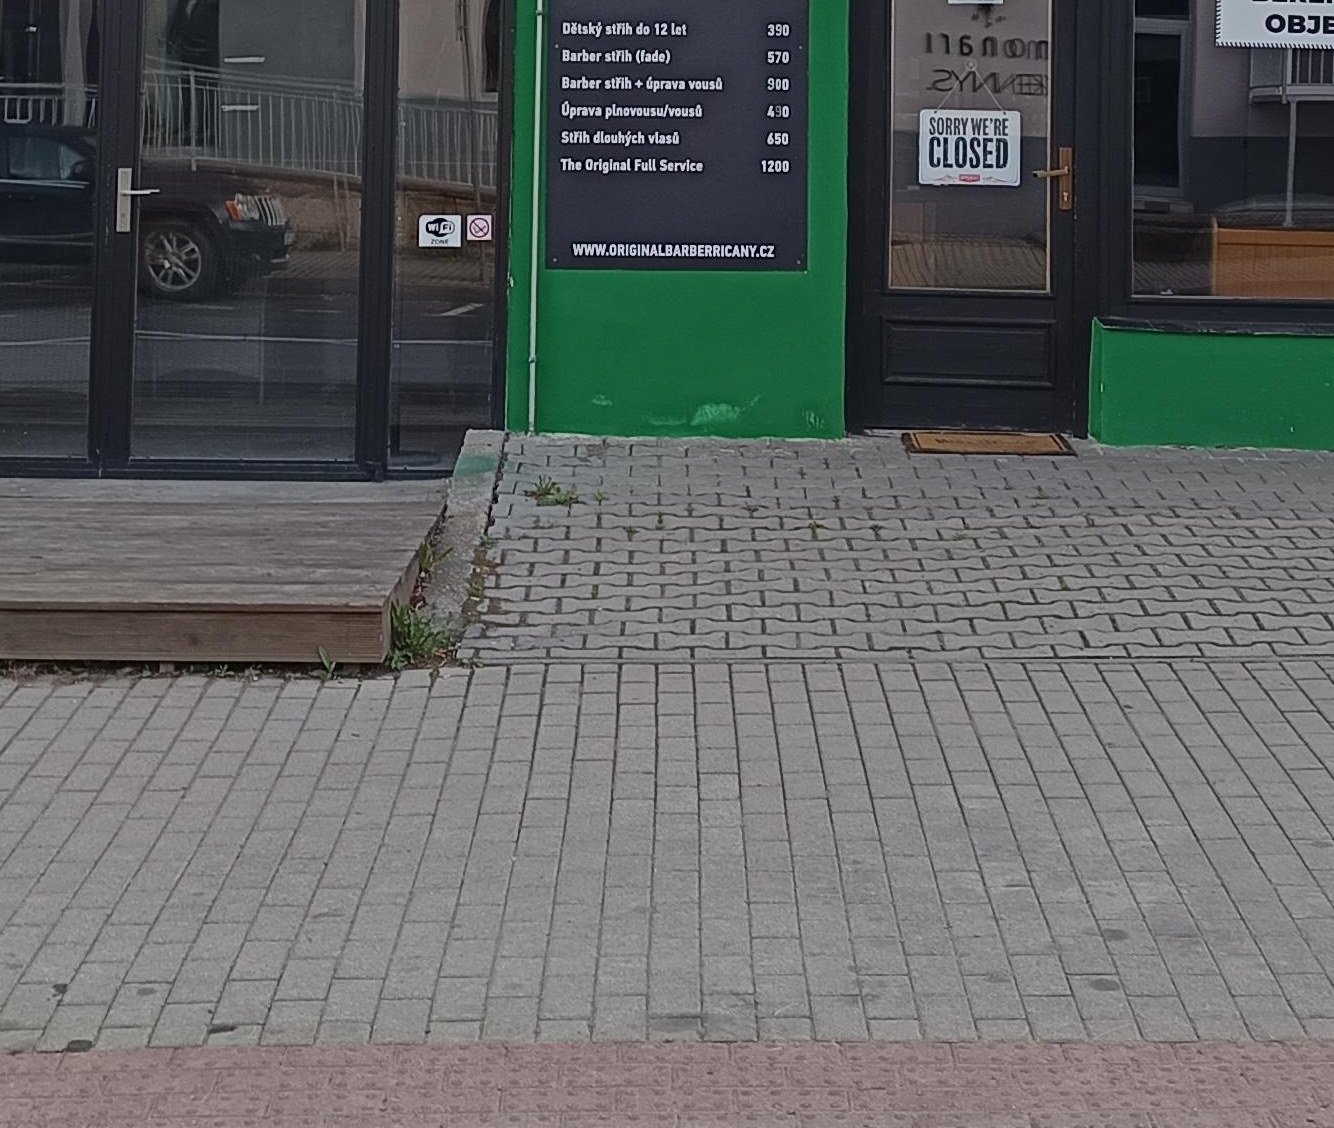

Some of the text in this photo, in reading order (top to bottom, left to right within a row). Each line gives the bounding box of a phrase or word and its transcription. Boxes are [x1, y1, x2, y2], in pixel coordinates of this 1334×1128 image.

[562, 22, 790, 37] Dětský střih do 12 let 390
[562, 49, 790, 64] Barber střih (fade) 570
[561, 76, 789, 92] Barber střih + úprava vousů 900
[561, 101, 789, 120] Úprava plnovousu/vousů 490
[929, 117, 1009, 136] SORRY WE'RE
[561, 130, 789, 147] Střih dlouhých vlasů 650
[928, 136, 1009, 169] CLOSED
[561, 158, 790, 174] The Original Full Service 1200
[573, 243, 775, 258] WWW.ORIGINALBARBERRICANY.CZ
